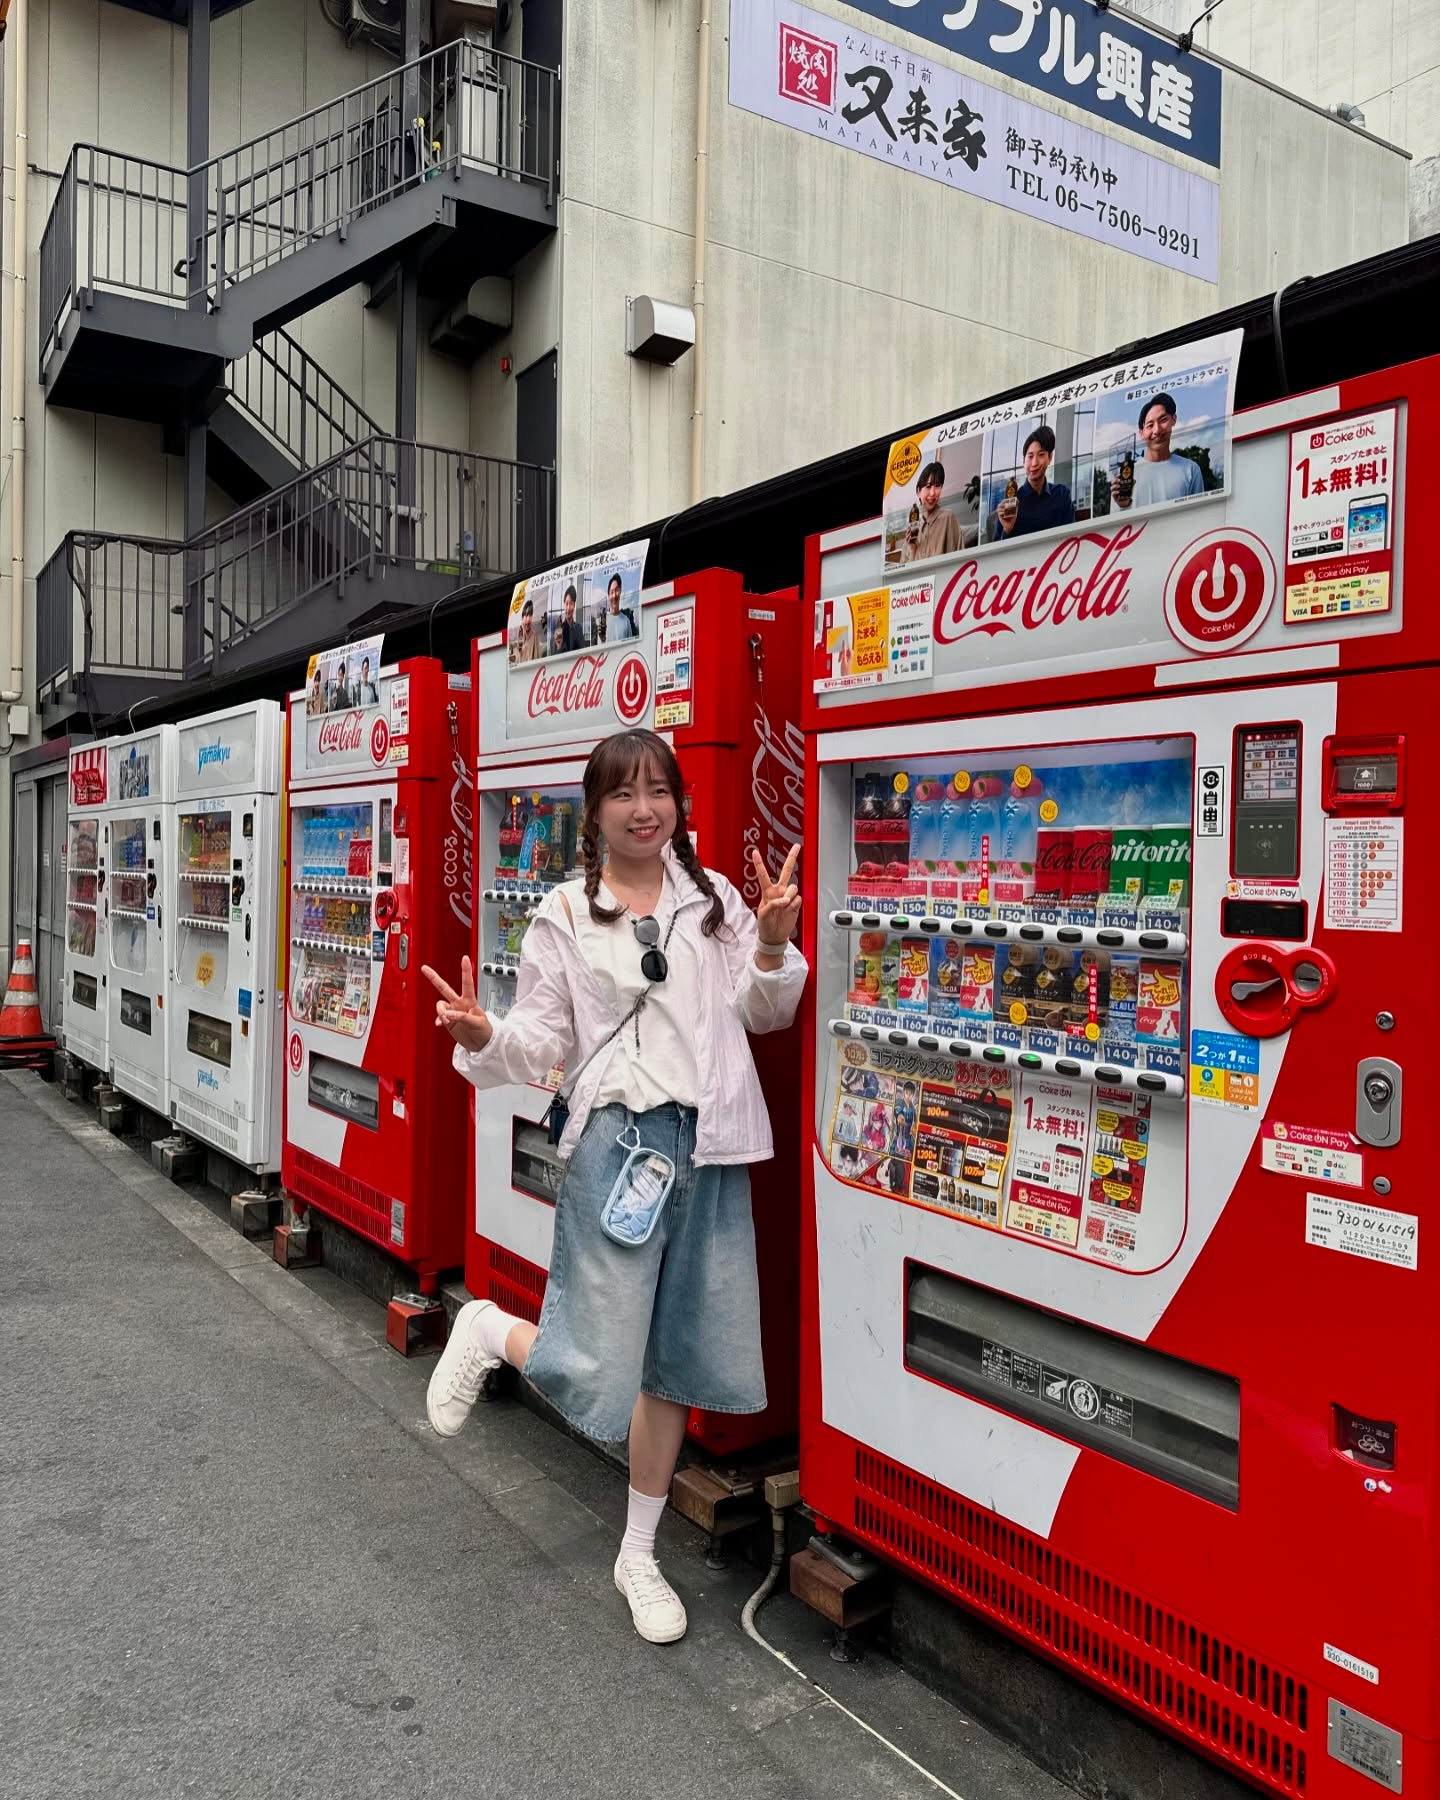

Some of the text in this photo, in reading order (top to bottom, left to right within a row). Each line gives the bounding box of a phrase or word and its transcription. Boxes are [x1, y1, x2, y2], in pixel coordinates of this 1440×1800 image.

[789, 40, 827, 78] 焼肉
[845, 35, 932, 84] なんば千日前
[842, 65, 987, 171] 又来家
[818, 117, 953, 178] MATARAIYA
[1004, 126, 1118, 194] 御予約承り中
[1006, 164, 1200, 260] TEL 06-7506-9291
[937, 361, 1163, 443] ひと息ついたら、景色が変わって見えた。
[892, 455, 920, 471] GEORGIA
[1330, 445, 1387, 464] スタンプたまると
[1353, 565, 1370, 575] Pay
[891, 596, 909, 610] Coke
[1292, 608, 1308, 616] VISA
[1243, 887, 1264, 896] Coke
[1280, 889, 1296, 899] Pay
[870, 1048, 953, 1078] コラボグッズが
[1047, 1104, 1085, 1118] スタンプたまると
[1290, 1130, 1313, 1142] Coke
[1330, 1137, 1349, 1150] Pay
[1058, 1203, 1071, 1215] Pay
[1337, 1209, 1360, 1226] 930
[1363, 1219, 1415, 1240] 0161519
[1327, 1650, 1375, 1681] 930-0161519
